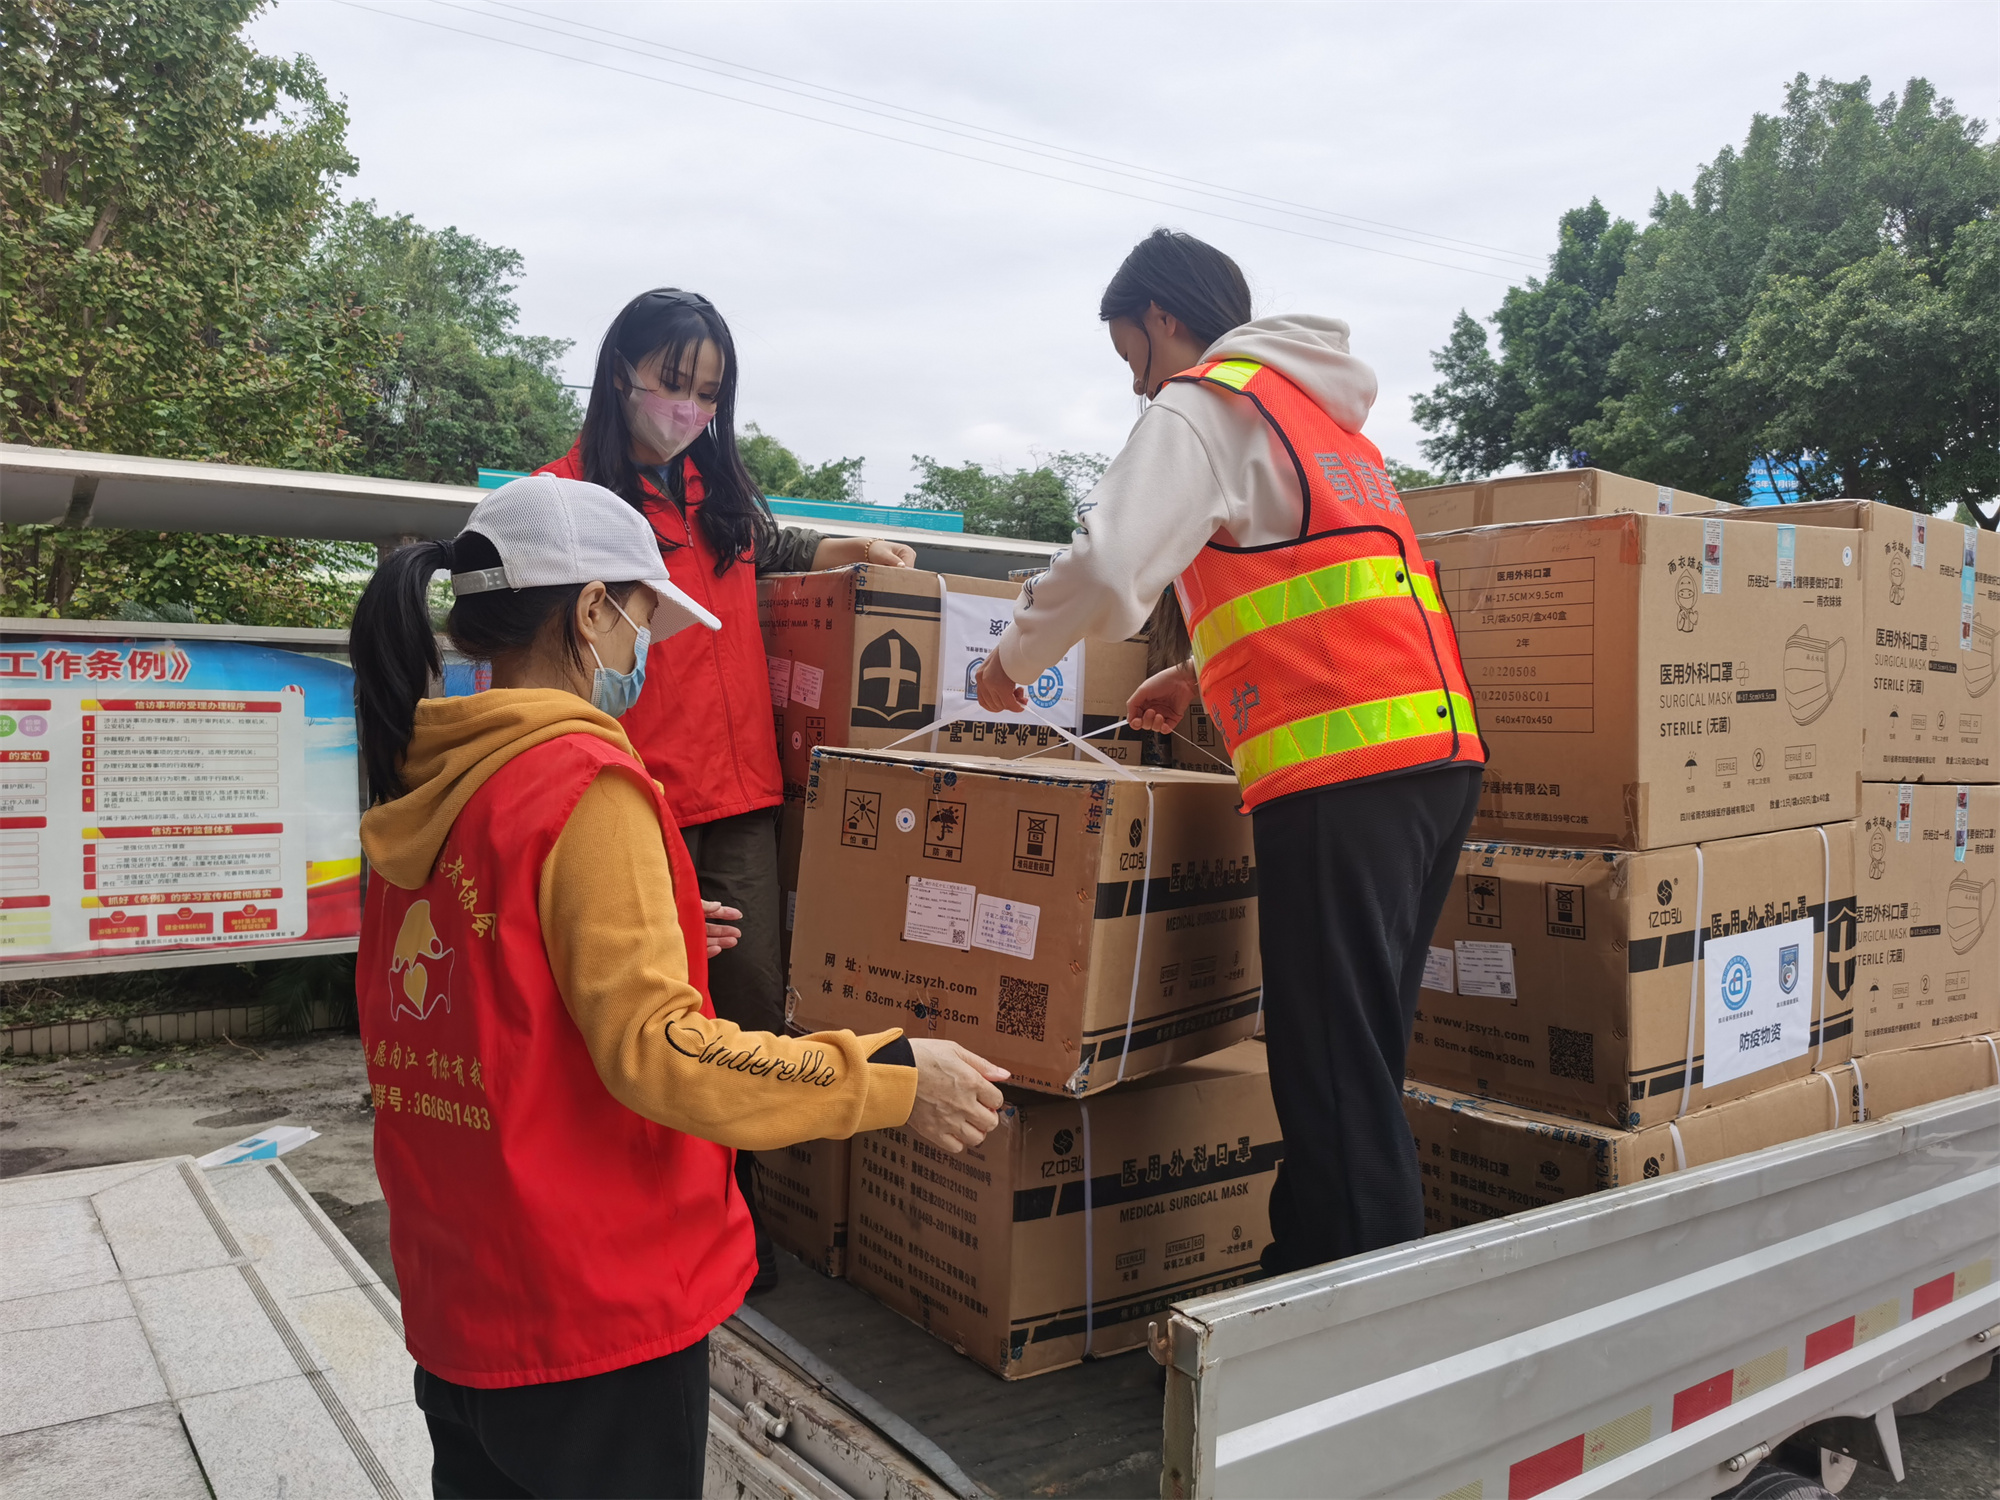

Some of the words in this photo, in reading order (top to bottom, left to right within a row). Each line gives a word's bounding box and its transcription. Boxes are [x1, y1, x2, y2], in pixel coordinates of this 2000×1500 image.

[1497, 568, 1551, 581] 医用外科口罩
[1516, 638, 1530, 648] 2年
[1876, 628, 1927, 651] 医用外科口罩
[0, 650, 190, 681] 工作条例》
[1875, 654, 1907, 669] SURGICAL
[1909, 658, 1927, 671] MASK
[1482, 666, 1537, 678] 20220508
[1660, 661, 1733, 686] 医用外科口罩
[1873, 677, 1904, 692] STERILE
[1475, 690, 1550, 702] 20220508C01
[1659, 691, 1706, 709] SURGICAL
[1708, 691, 1733, 706] MASK
[135, 701, 246, 711] 信访事项的受理办理程序
[1495, 715, 1552, 725] 640x470x450
[1660, 721, 1702, 737] STERILE
[9, 752, 43, 761] 的定位
[1717, 761, 1736, 772] STERILE
[151, 825, 234, 836] 信访工作监督体系
[1166, 914, 1195, 932] MEDICAL
[1196, 910, 1227, 926] SURGICAL
[1229, 905, 1246, 919] MASK
[1649, 907, 1682, 928] 亿中弘
[1855, 903, 1909, 923] 医用外科口罩
[1854, 927, 1887, 944] URGICAL
[1888, 927, 1908, 940] MASK
[1854, 951, 1884, 967] TERILE
[868, 963, 978, 997] www.jzsyzh.com
[1433, 1015, 1530, 1044] www.jzsyzh.com
[1739, 1023, 1782, 1052] 防疫物资
[665, 1020, 837, 1087] Cinderella
[1041, 1154, 1085, 1179] 亿中弘
[1121, 1136, 1251, 1187] 医用外科口罩
[1450, 1148, 1510, 1177] 医用外科口罩
[1119, 1202, 1165, 1223] MEDICAL
[1169, 1189, 1218, 1212] SURGICAL
[1221, 1182, 1249, 1201] MASK
[1168, 1240, 1191, 1256] STERILE
[1118, 1252, 1144, 1267] STERILE
